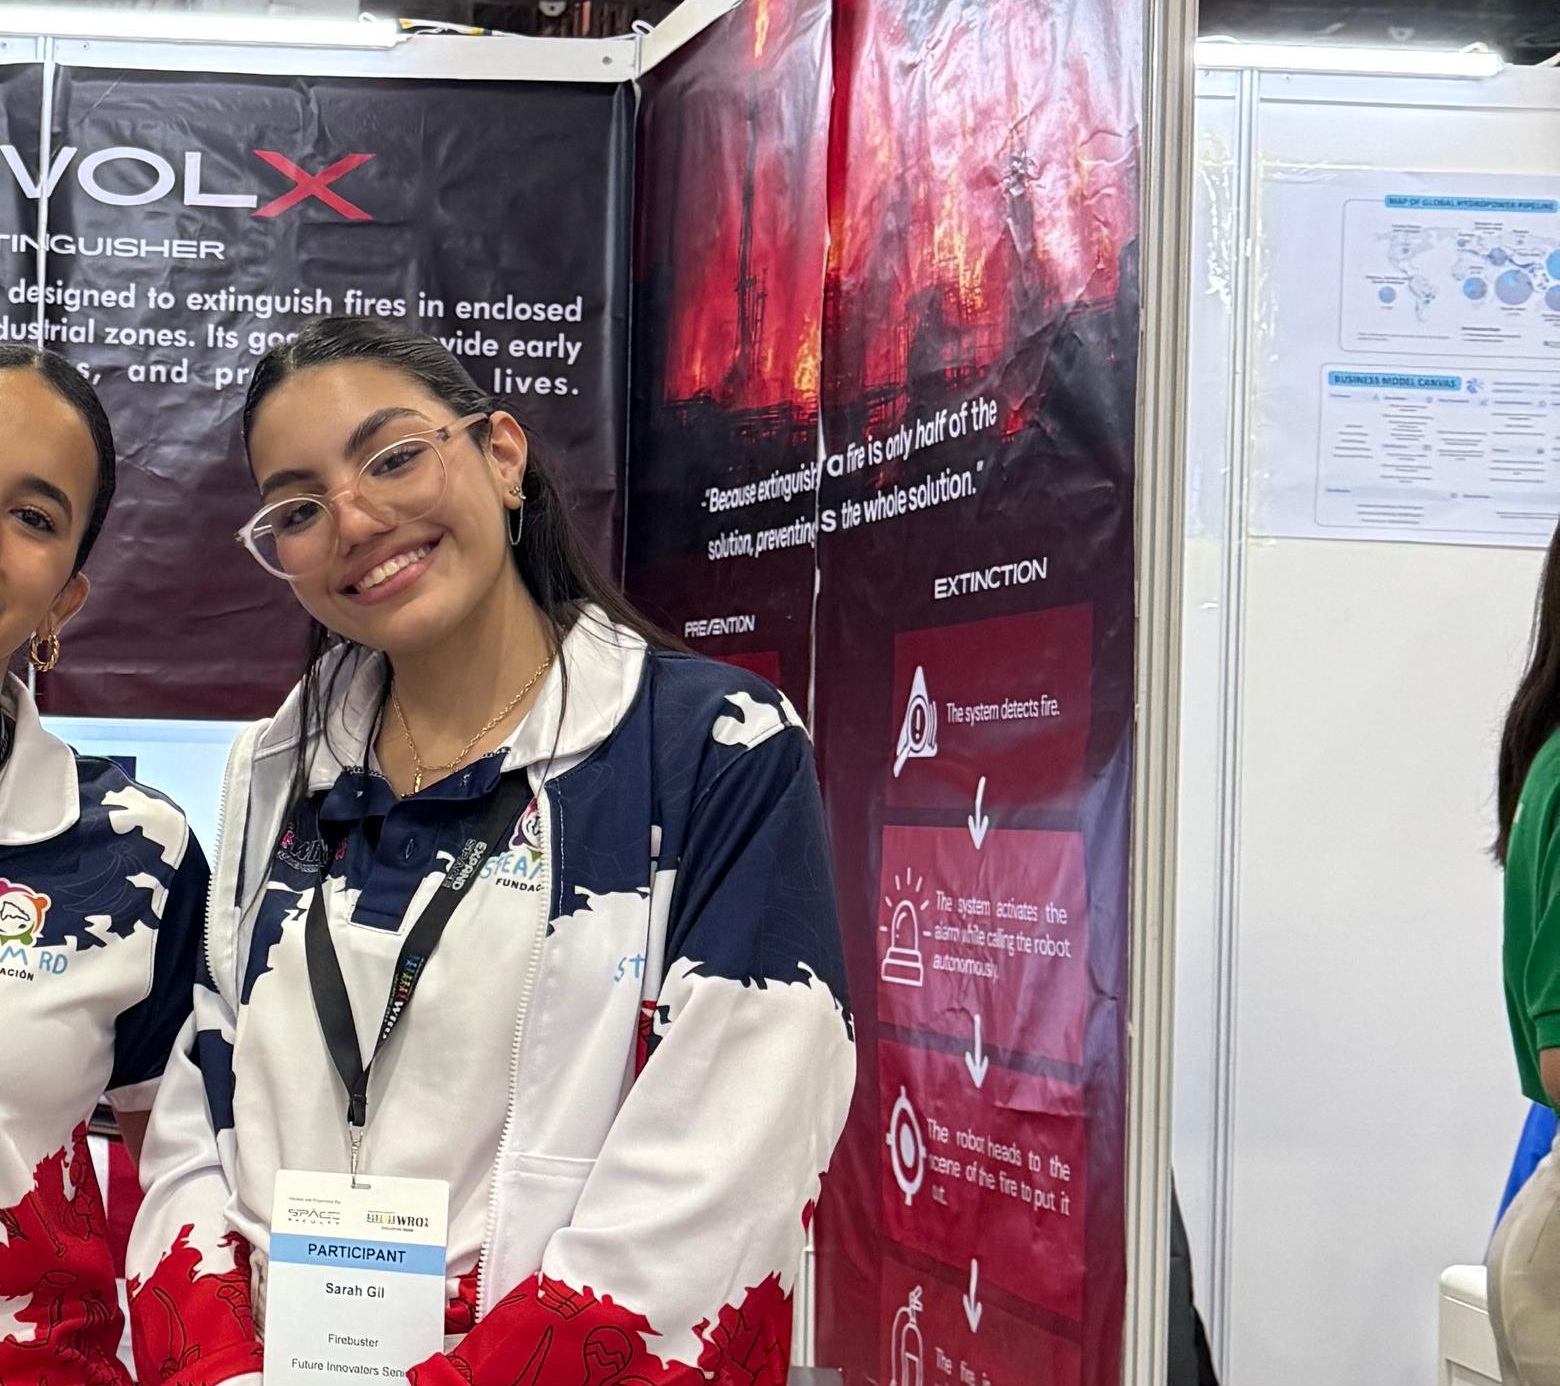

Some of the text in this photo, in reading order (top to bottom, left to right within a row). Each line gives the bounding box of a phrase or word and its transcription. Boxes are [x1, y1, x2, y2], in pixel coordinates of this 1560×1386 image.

[8, 279, 136, 312] designed
[147, 287, 175, 310] to
[186, 287, 332, 317] extinguish
[344, 290, 406, 317] fires
[418, 291, 444, 317] in
[455, 296, 583, 323] enclosed
[104, 325, 195, 348] zones.
[207, 324, 239, 349] Its
[509, 333, 583, 365] early
[128, 358, 188, 384] and
[493, 370, 578, 396] lives.
[1334, 375, 1456, 388] BUSINESS MODEL CANVAS
[826, 454, 844, 478] a
[846, 442, 865, 474] fire
[868, 434, 883, 466] is
[885, 424, 913, 461] only
[915, 409, 947, 450] half
[949, 401, 968, 438] of
[971, 397, 997, 432] the
[708, 529, 753, 561] solution,
[841, 499, 861, 530] the
[863, 485, 907, 524] whole
[934, 557, 1047, 600] EXTINCTION
[946, 694, 1060, 727] The system detects fire.
[936, 890, 1068, 925] The system activates the
[1016, 931, 1032, 954] the
[1033, 934, 1072, 958] robot
[38, 951, 69, 974] RD
[926, 1117, 1070, 1181] The robot heads to the
[965, 1160, 978, 1182] of
[978, 1166, 996, 1190] the
[999, 1169, 1017, 1197] fire
[1020, 1181, 1032, 1203] to
[1034, 1188, 1057, 1211] put
[1060, 1191, 1071, 1216] it
[308, 1243, 406, 1264] PARTICIPANT
[325, 1282, 385, 1298] Sarah Gil
[328, 1333, 379, 1348] Firebuster
[291, 1358, 324, 1371] Future
[327, 1361, 379, 1376] Innovators
[935, 1346, 952, 1375] The
